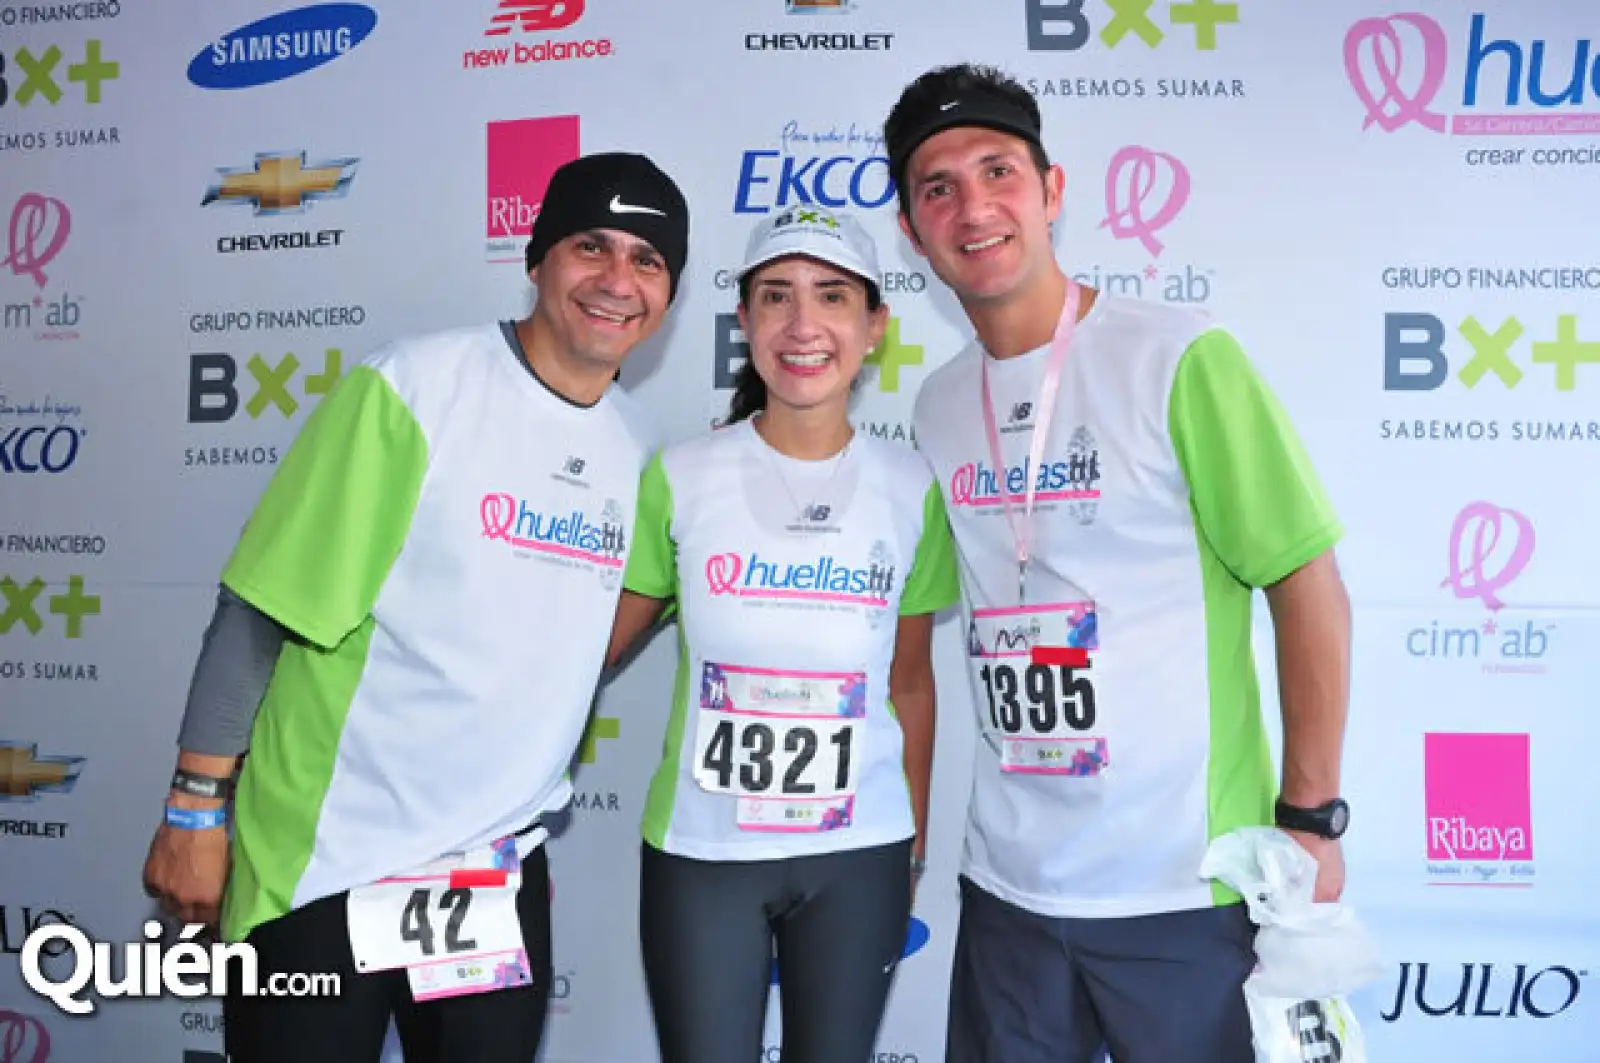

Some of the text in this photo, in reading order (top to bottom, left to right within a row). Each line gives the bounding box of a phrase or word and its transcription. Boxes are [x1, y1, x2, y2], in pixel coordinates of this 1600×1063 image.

[21, 0, 121, 23] FINANCIERO
[211, 27, 351, 66] SAMSUNG
[462, 38, 612, 69] new balance
[744, 34, 895, 50] CHEVROLET
[1463, 13, 1600, 106] hu
[1028, 79, 1245, 97] SABEMOS SUMAR
[55, 127, 120, 148] SUMAR
[1466, 149, 1525, 165] crear
[733, 150, 896, 213] EKCO
[217, 230, 344, 253] CHEVROLET
[1382, 267, 1600, 289] GRUPO FINANCIERO
[190, 306, 365, 333] GRUPO FINANCIERO
[1380, 419, 1600, 442] SABEMOS SUMAR
[184, 447, 278, 467] SABEMOS
[515, 500, 601, 553] huellas
[7, 534, 106, 554] FINANCIERO
[744, 552, 869, 594] huellas
[33, 661, 98, 681] SUMAR
[980, 656, 1097, 733] 1395
[702, 719, 853, 794] 4321
[1428, 816, 1527, 860] Ribaya
[400, 887, 477, 956] 42
[1380, 962, 1581, 1022] JULIO
